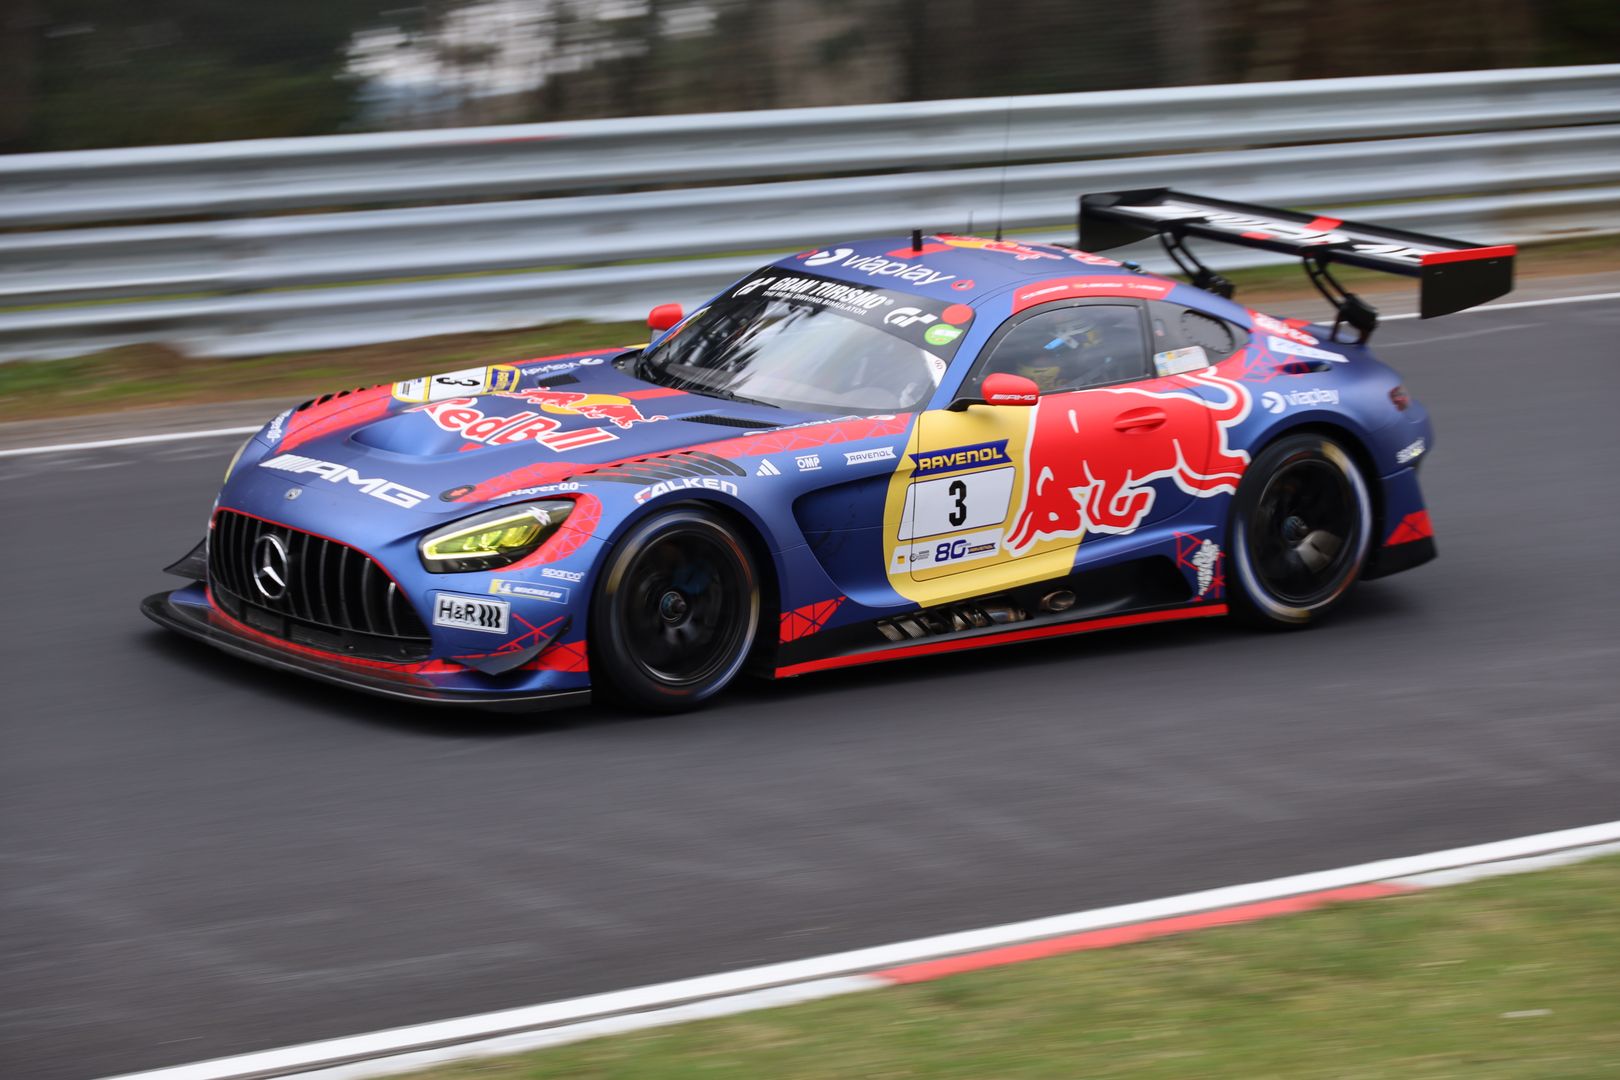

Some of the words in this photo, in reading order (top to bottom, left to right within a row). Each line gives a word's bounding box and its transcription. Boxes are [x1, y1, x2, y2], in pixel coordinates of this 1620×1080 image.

[842, 254, 956, 285] viaplay
[767, 277, 820, 294] GRAN
[821, 299, 868, 315] SIMULATOR
[436, 376, 481, 387] 3
[1284, 388, 1340, 407] viaplay
[486, 415, 621, 452] Bll
[796, 458, 820, 469] OMP
[849, 450, 892, 462] RAVENOL
[918, 447, 1003, 471] RAVENOL
[296, 461, 431, 509] AMG
[634, 477, 738, 504] FALKEN
[948, 480, 967, 527] 3
[541, 568, 581, 580] sparco
[439, 600, 475, 622] H&R
